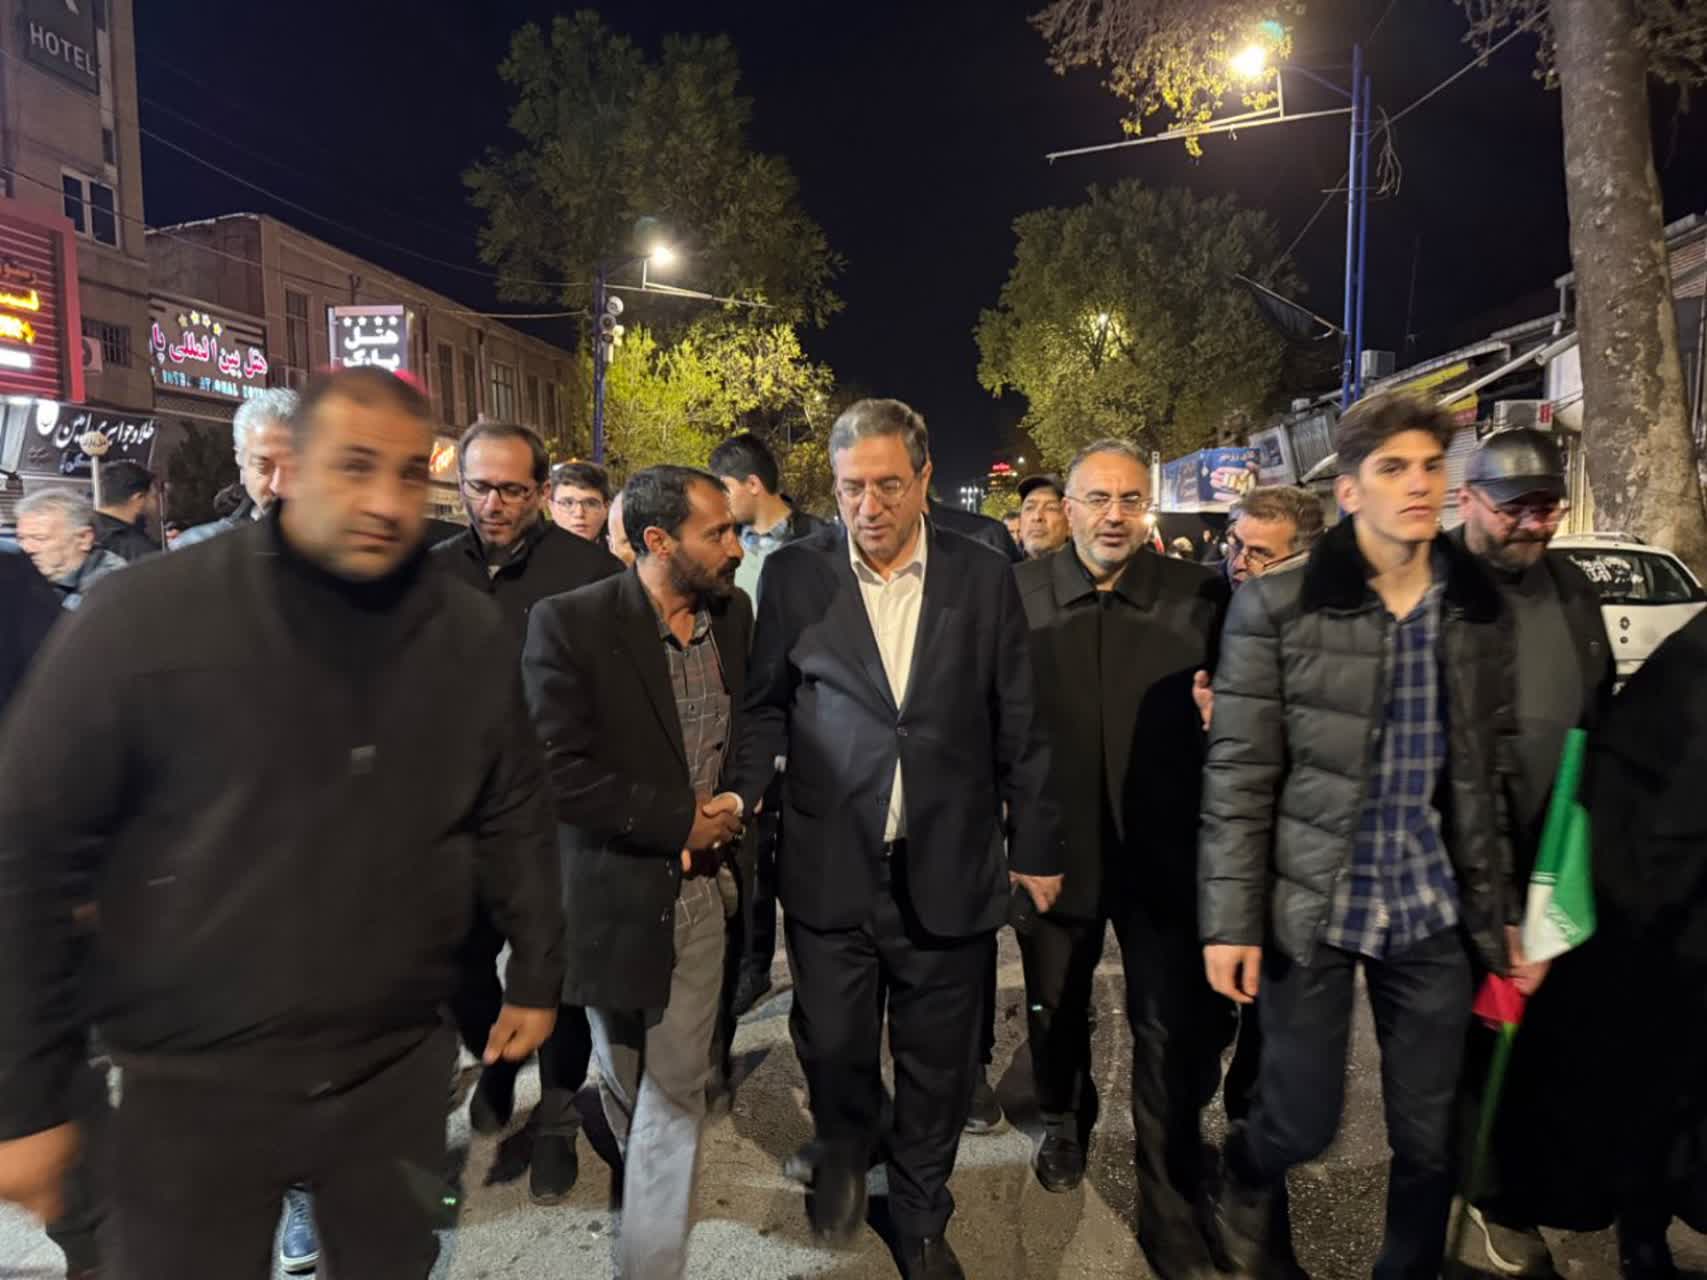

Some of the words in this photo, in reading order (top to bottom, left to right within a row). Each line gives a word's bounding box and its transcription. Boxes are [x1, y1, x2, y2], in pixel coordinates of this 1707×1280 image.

[30, 21, 96, 76] HOTEL
[169, 331, 218, 363] المللی
[344, 326, 399, 350] هتل
[218, 347, 241, 379] بین
